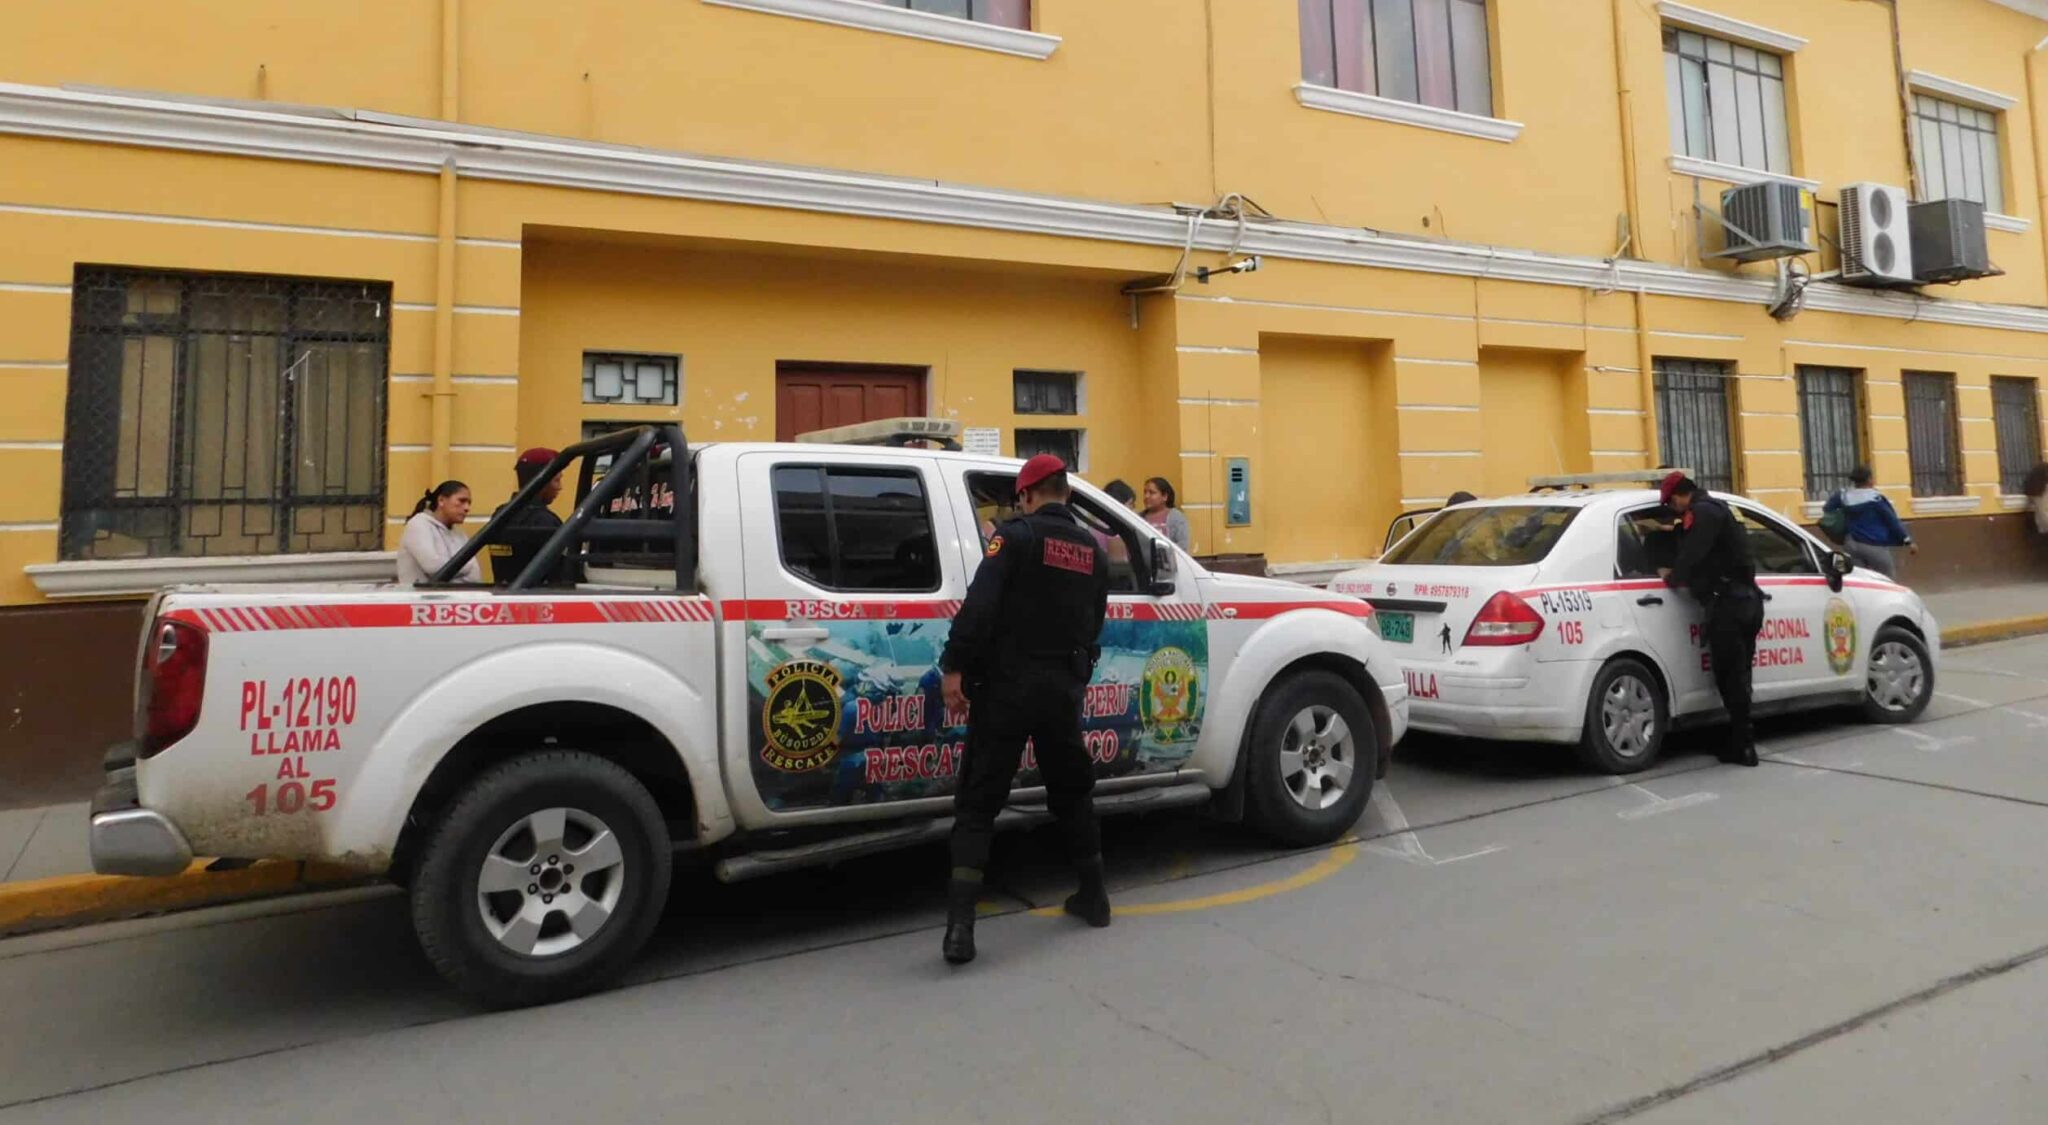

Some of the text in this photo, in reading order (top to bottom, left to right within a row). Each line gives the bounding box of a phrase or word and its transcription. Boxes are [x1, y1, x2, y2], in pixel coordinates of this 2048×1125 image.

[1047, 540, 1092, 564] RESCATE
[410, 603, 553, 625] RESCATE
[1540, 590, 1593, 614] PL-15319
[1557, 621, 1583, 645] 105
[1757, 617, 1810, 640] ACIONAL
[772, 663, 837, 684] POLICIA
[241, 676, 356, 731] PL-12190
[251, 728, 341, 756] LLAMA
[277, 756, 310, 780] AL
[765, 745, 835, 769] RESCATE
[864, 742, 966, 784] RESCAT
[246, 779, 337, 817] 105
